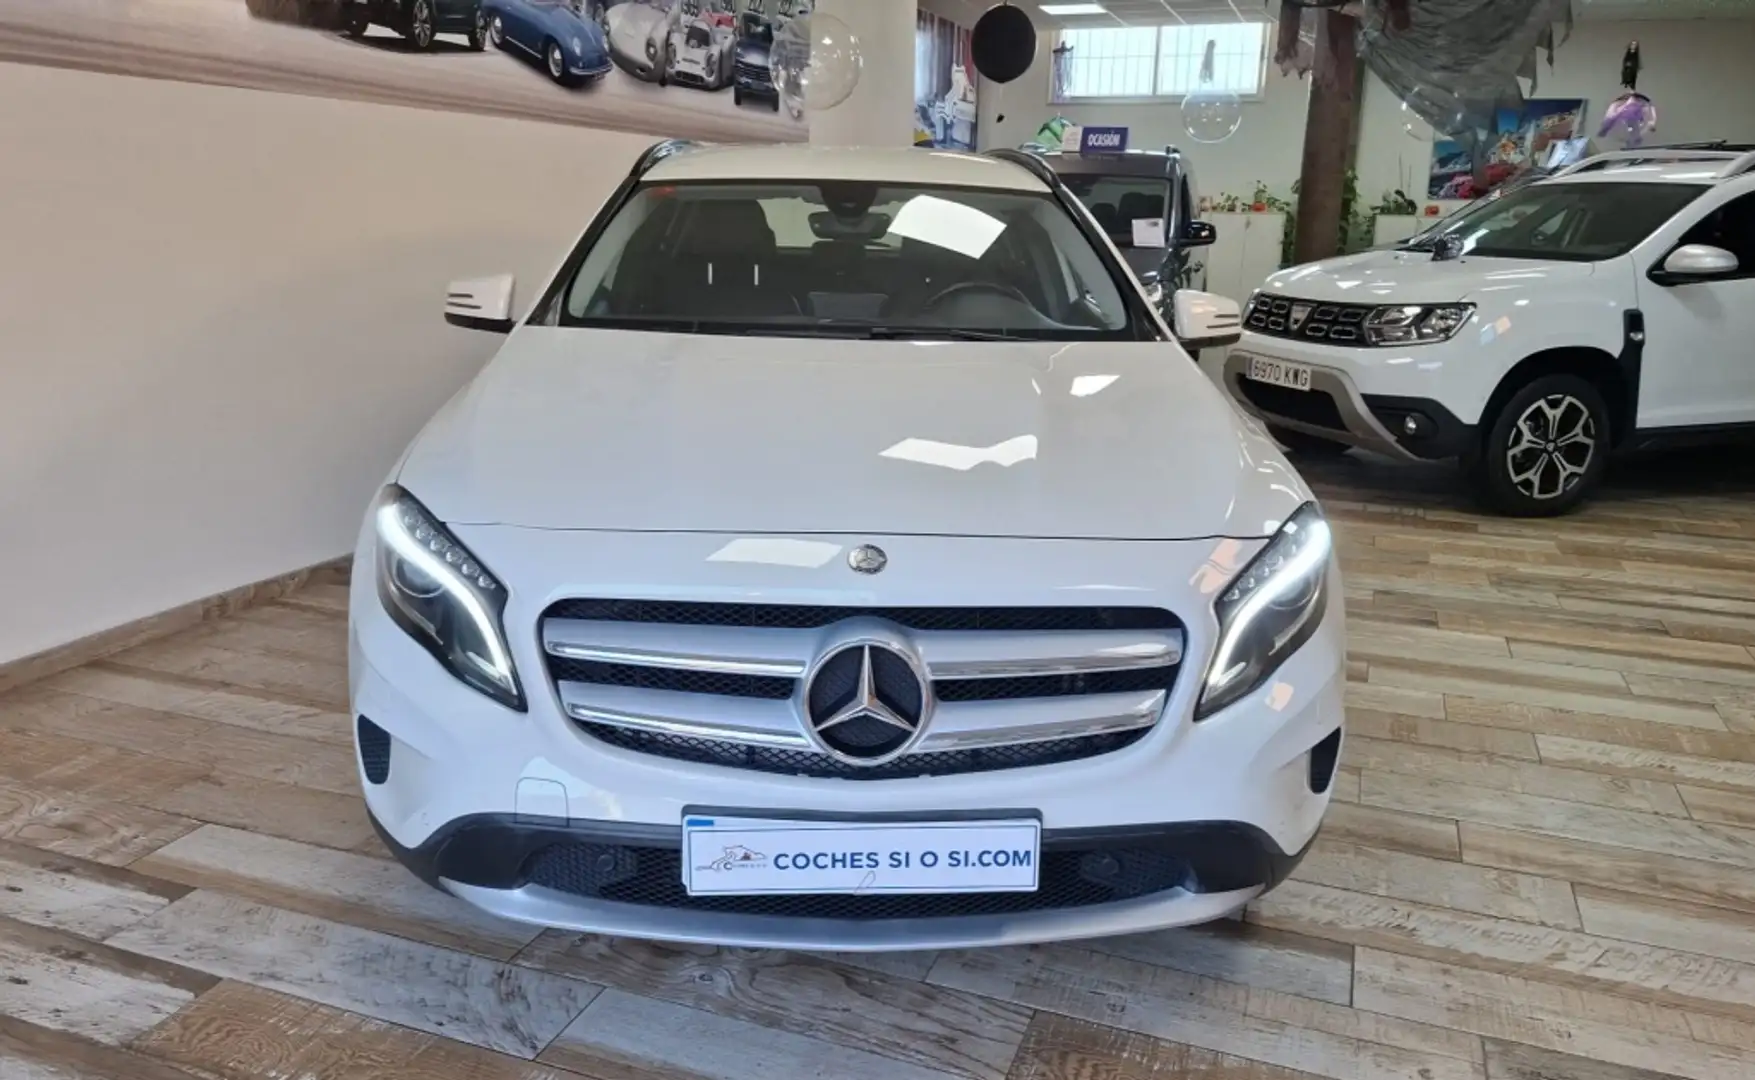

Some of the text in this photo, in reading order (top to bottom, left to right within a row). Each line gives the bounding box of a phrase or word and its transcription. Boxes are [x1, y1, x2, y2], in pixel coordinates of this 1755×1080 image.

[1087, 131, 1121, 146] OCASIÓN
[1253, 360, 1282, 381] 6970
[773, 851, 880, 870] COCHES
[888, 850, 911, 869] SI
[920, 850, 939, 869] O
[947, 849, 1032, 868] SI.COM
